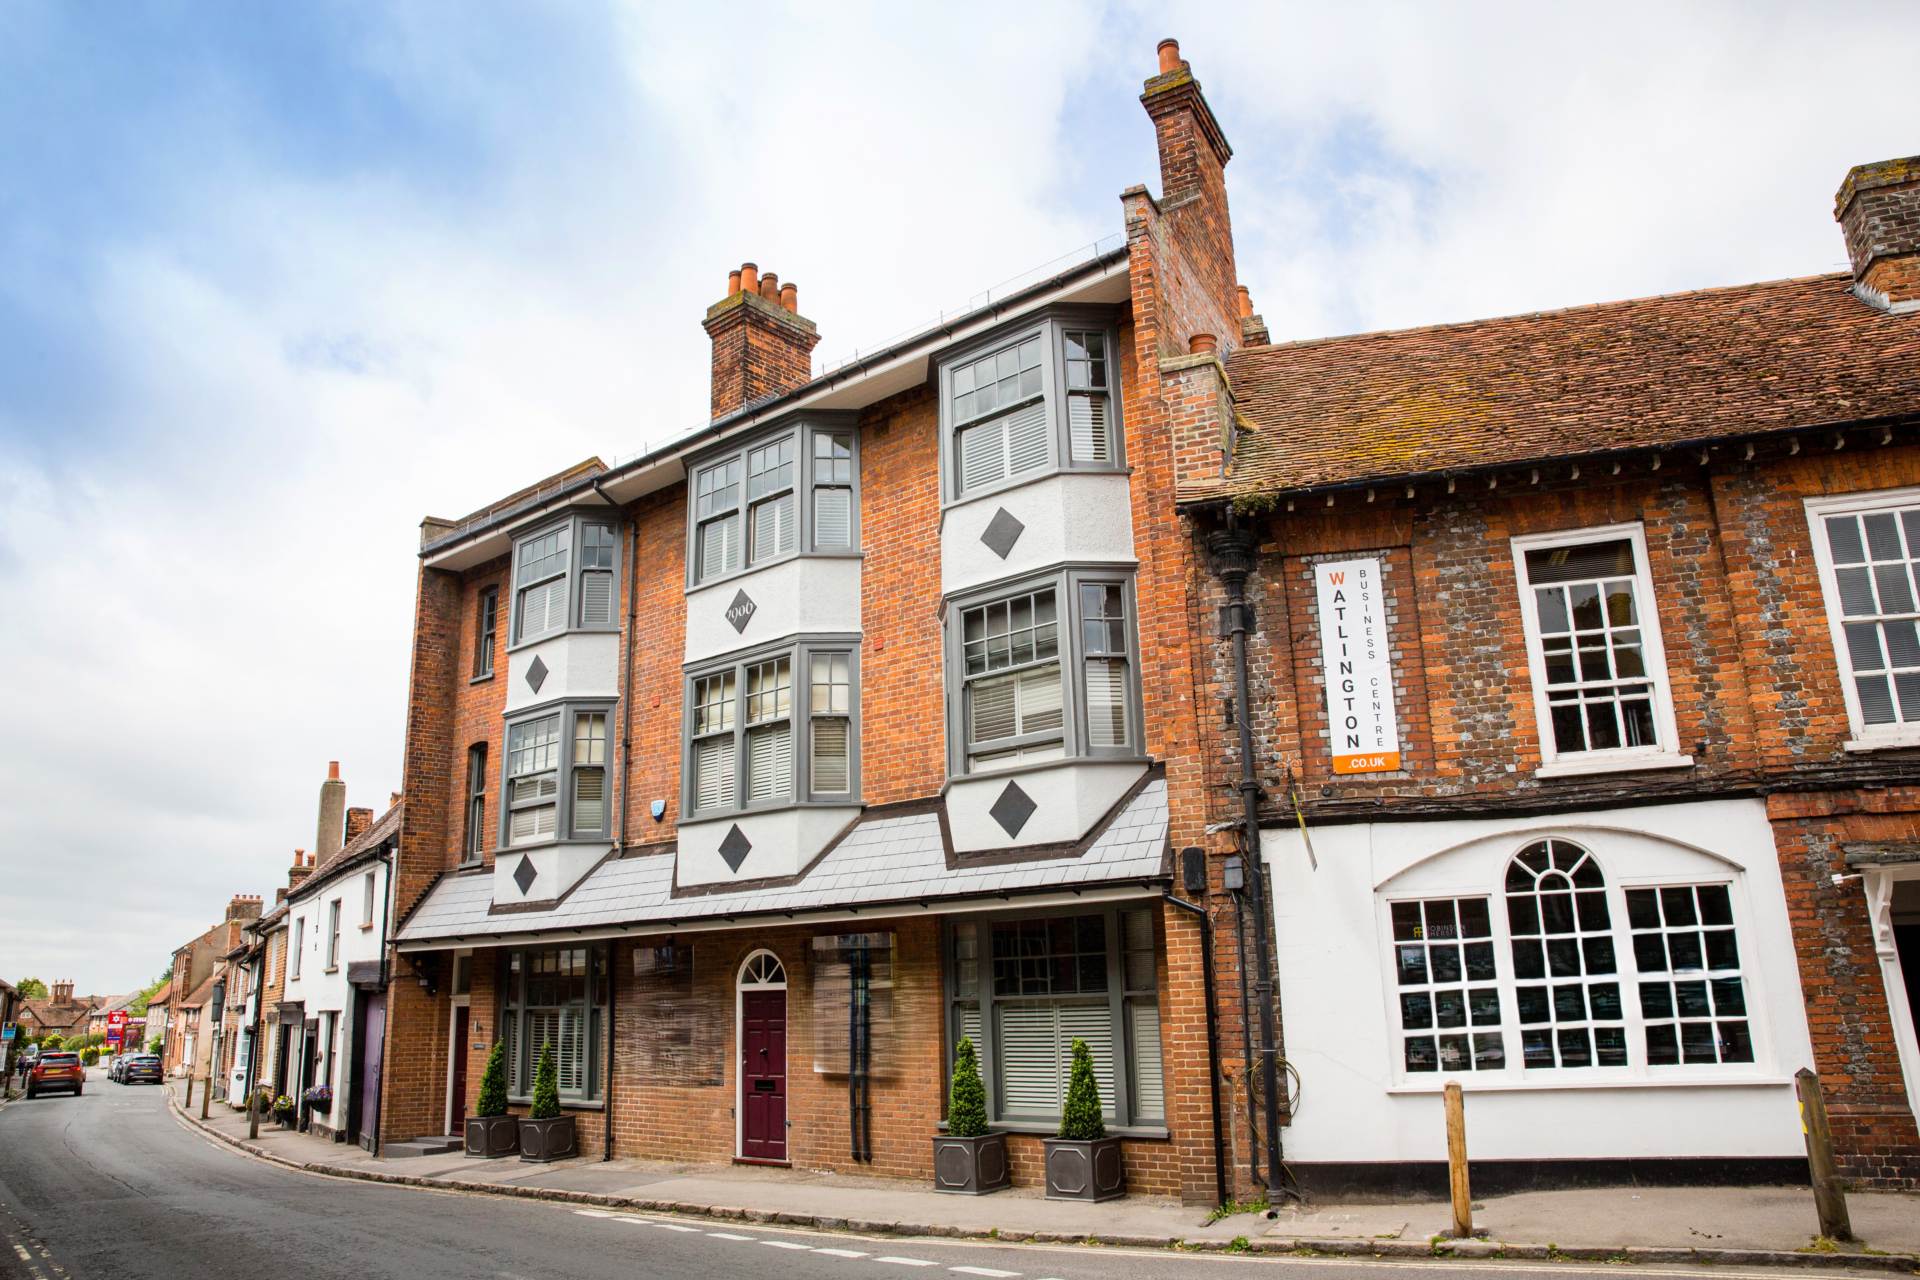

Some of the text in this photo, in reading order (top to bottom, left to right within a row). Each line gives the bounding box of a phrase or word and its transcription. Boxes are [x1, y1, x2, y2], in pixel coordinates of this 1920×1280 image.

[728, 600, 754, 624] 1906
[1329, 572, 1360, 748] WATLINGTON
[1360, 570, 1384, 747] BUSINESS CENTRE
[1348, 757, 1385, 768] .CO.UK
